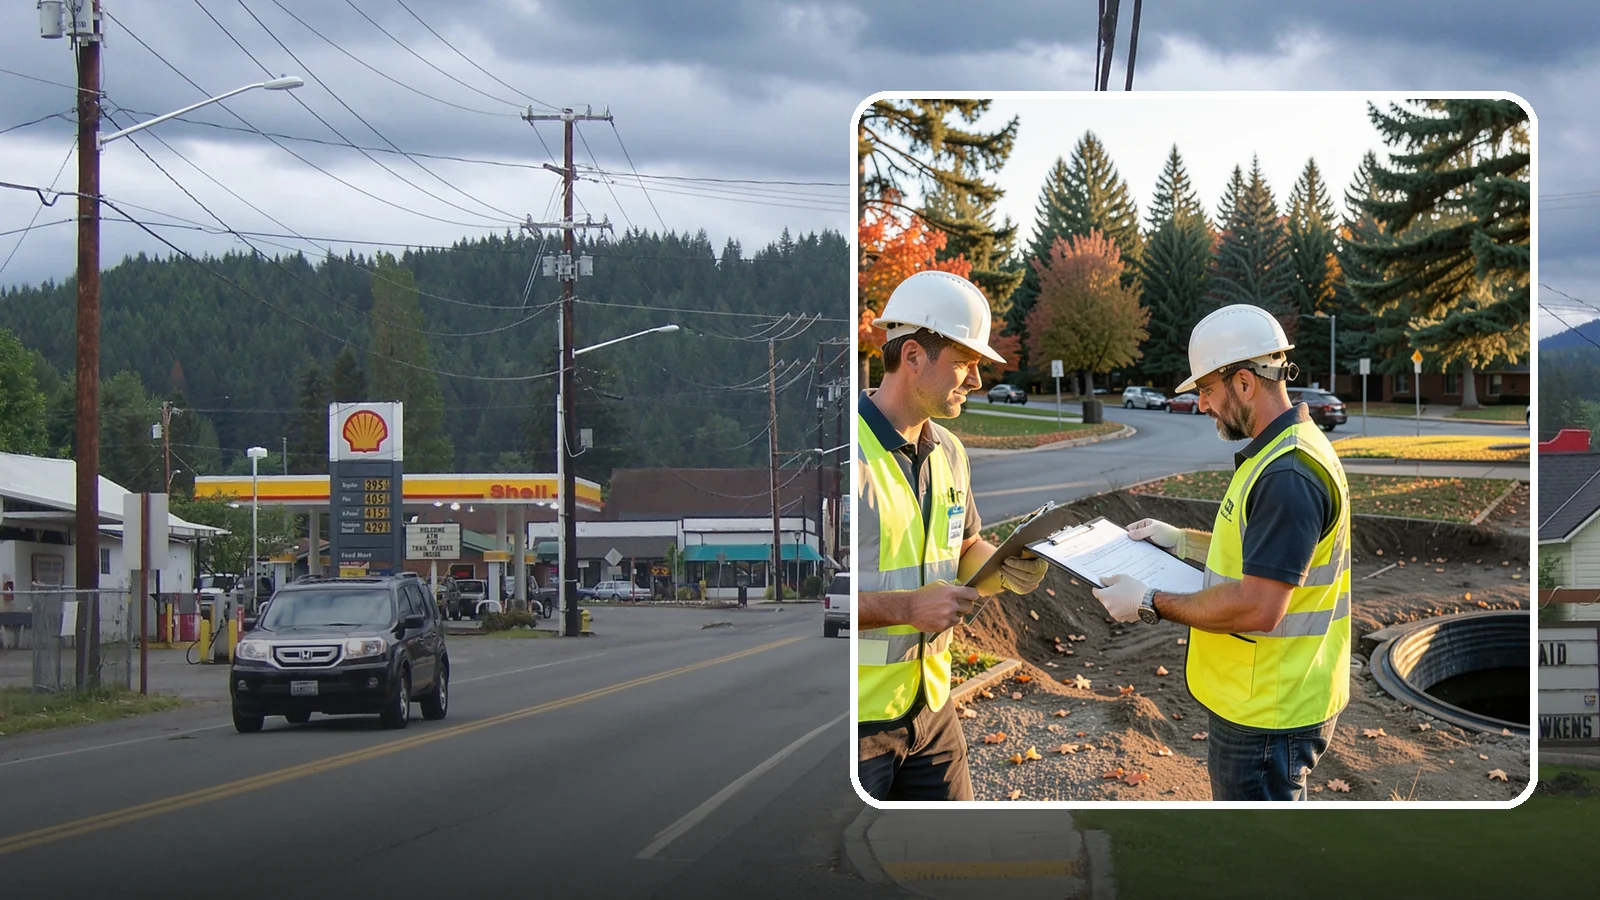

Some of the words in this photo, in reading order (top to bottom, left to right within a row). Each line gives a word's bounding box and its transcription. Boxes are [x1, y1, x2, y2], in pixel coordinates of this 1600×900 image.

[365, 480, 383, 490] 395
[490, 484, 547, 498] Shell
[365, 494, 383, 504] 405
[365, 508, 383, 518] 415
[366, 522, 383, 532] 429
